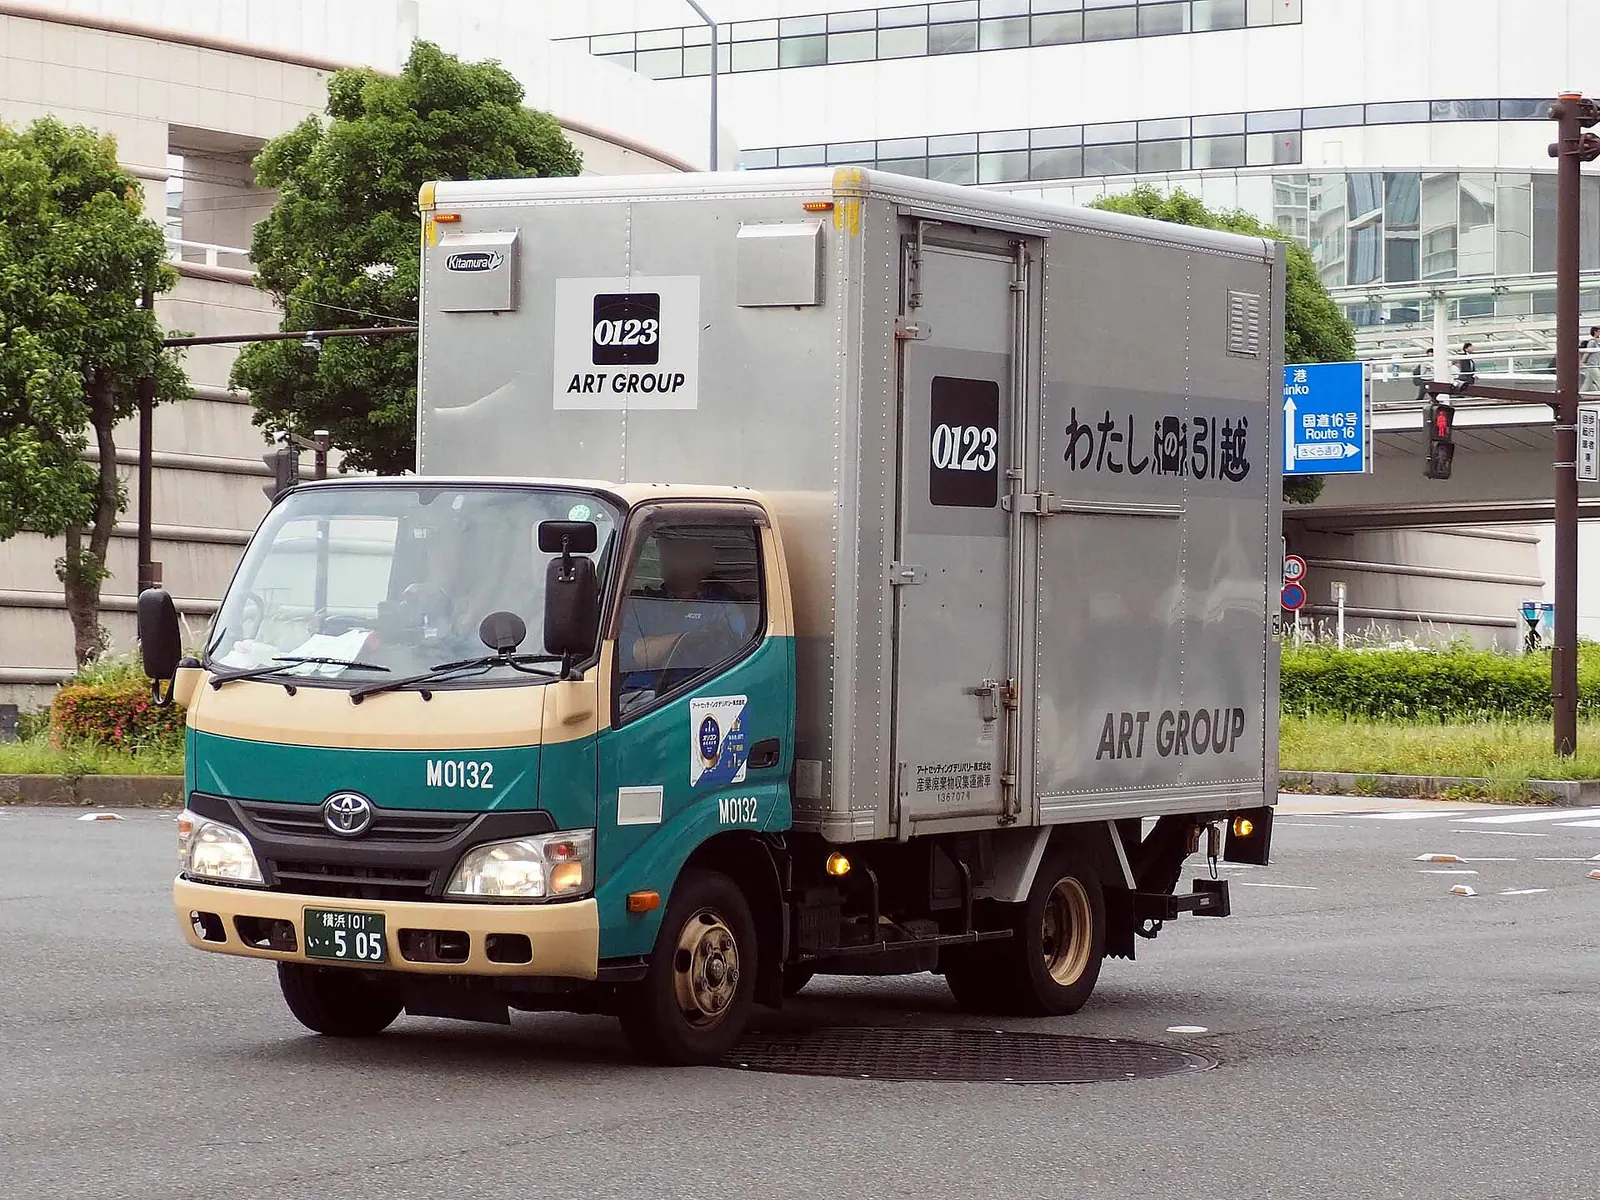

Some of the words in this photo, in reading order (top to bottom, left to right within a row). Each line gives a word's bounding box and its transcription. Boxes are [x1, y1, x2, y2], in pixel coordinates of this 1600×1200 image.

[448, 255, 488, 269] Kitamura
[594, 319, 658, 346] 0123
[567, 373, 607, 393] ART
[612, 373, 685, 393] GROUP
[1302, 412, 1358, 428] 国道16号
[1306, 428, 1338, 439] Route
[1342, 427, 1355, 438] 16
[932, 423, 997, 471] 0123
[1301, 446, 1340, 456] さくら通り
[1285, 563, 1300, 575] 40
[1096, 711, 1150, 760] ART
[1156, 708, 1245, 757] GROUP
[427, 760, 493, 788] M0132
[719, 797, 757, 823] M0132
